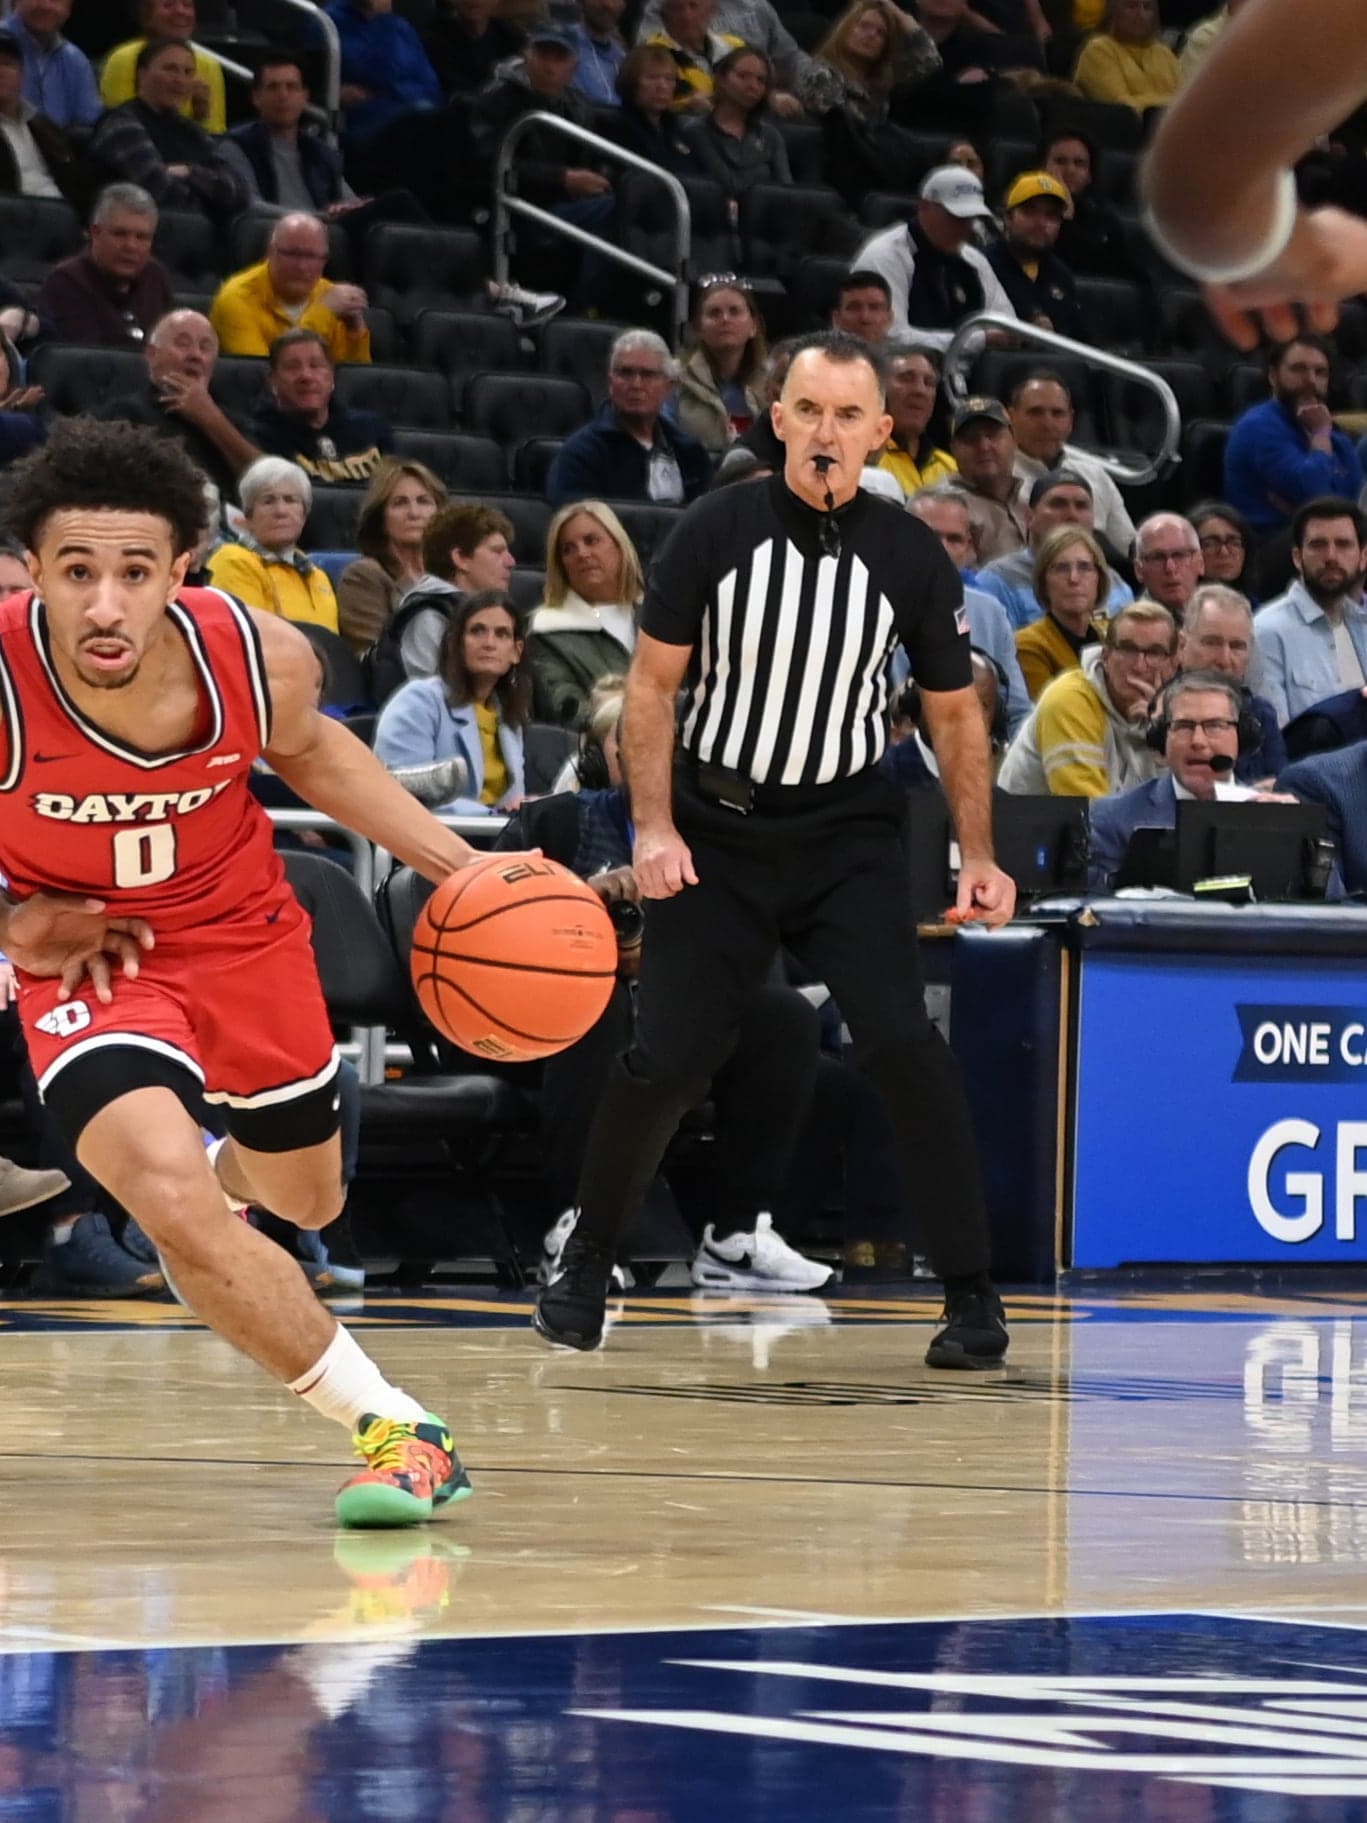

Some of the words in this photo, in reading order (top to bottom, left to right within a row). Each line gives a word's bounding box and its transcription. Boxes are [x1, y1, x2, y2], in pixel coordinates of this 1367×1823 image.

[33, 778, 232, 824] DAYTO
[113, 823, 176, 889] 0
[1253, 1021, 1331, 1065] ONE
[1339, 1022, 1367, 1066] C
